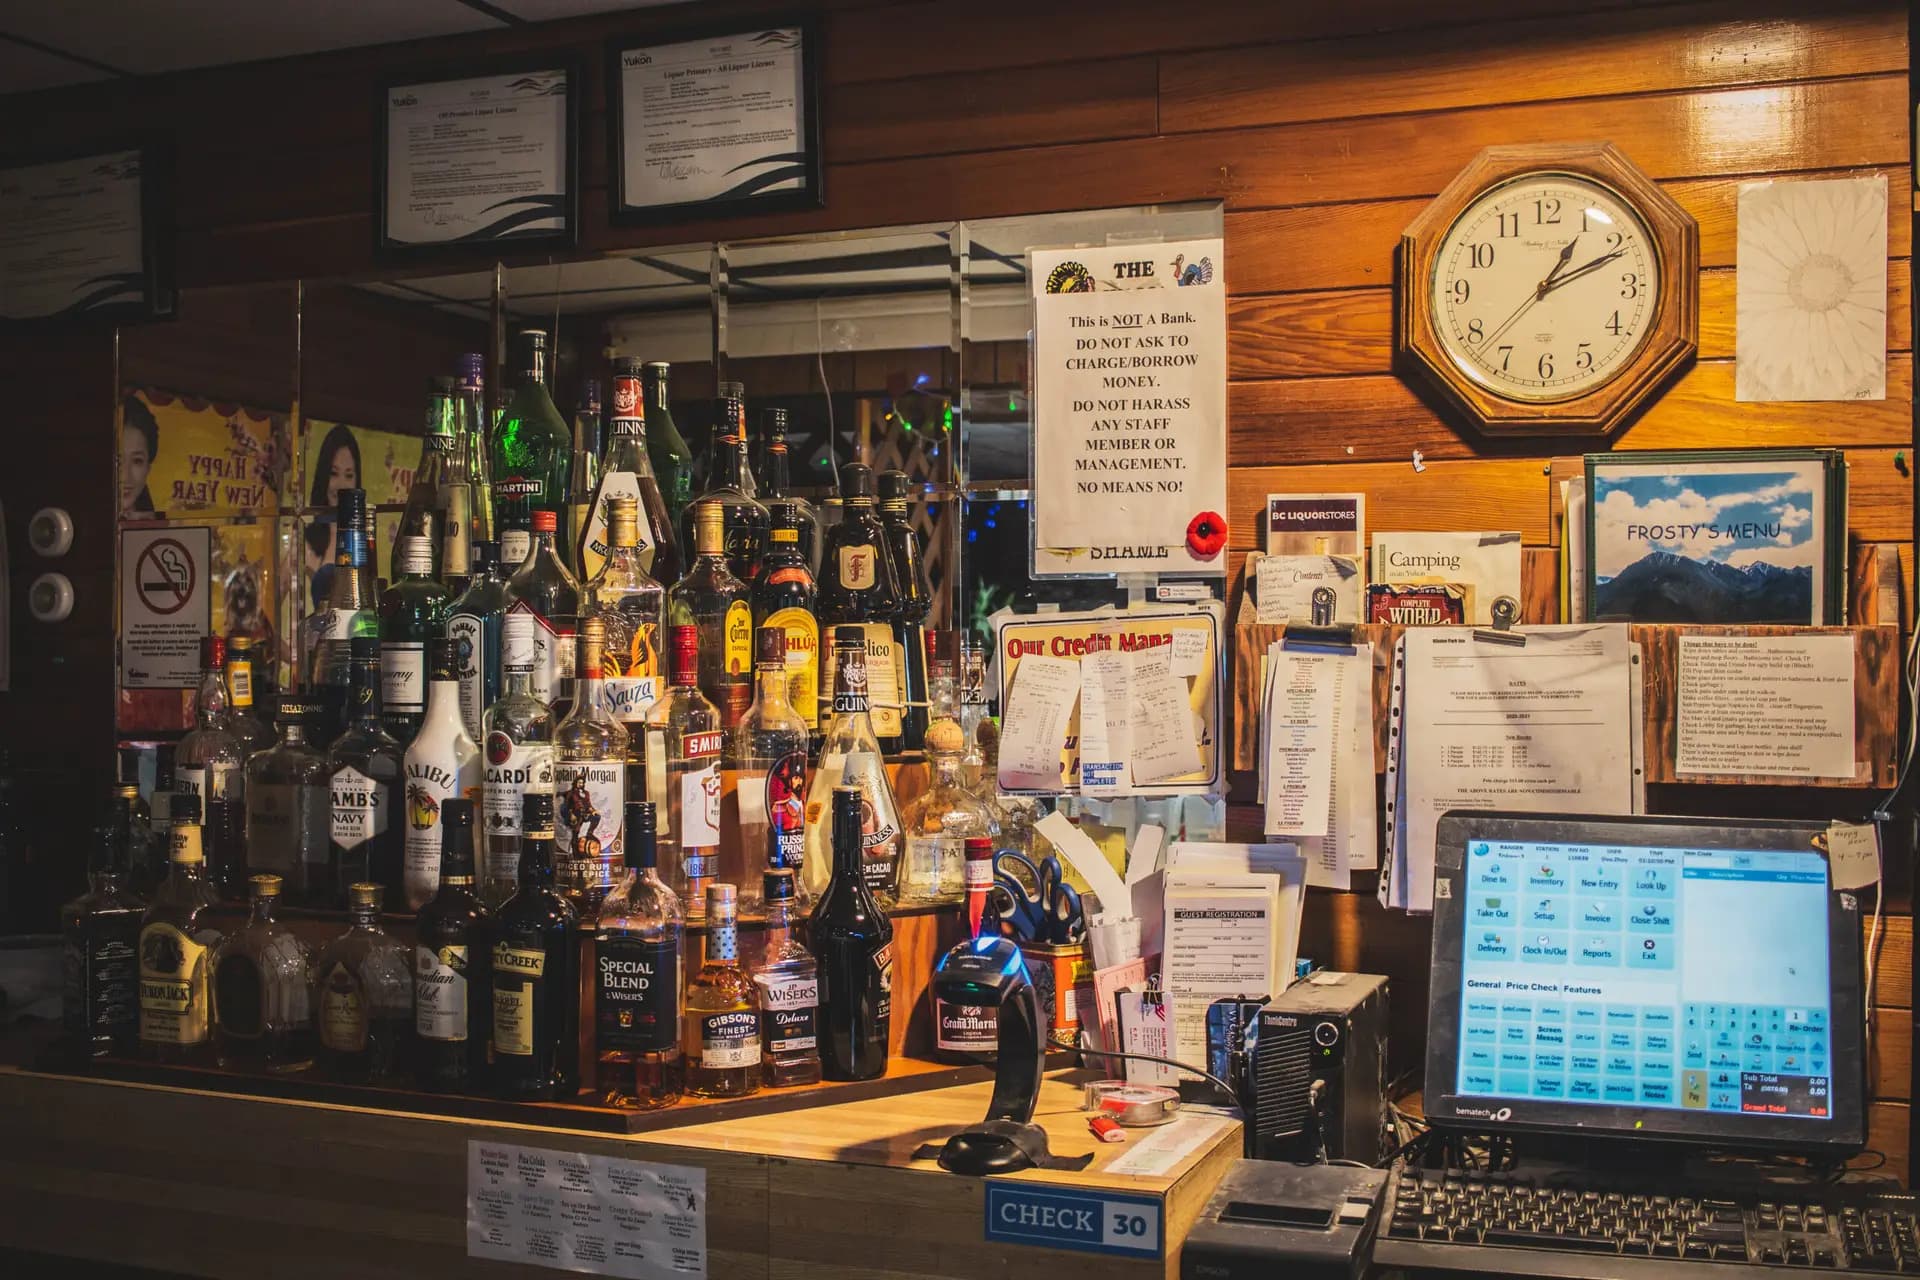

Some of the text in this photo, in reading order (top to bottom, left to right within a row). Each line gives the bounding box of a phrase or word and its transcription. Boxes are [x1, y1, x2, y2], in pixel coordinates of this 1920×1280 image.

[624, 54, 652, 67] Yukon
[1534, 199, 1562, 225] 12
[1581, 206, 1593, 233] 1
[1497, 212, 1521, 239] 11
[1466, 242, 1495, 269] 10
[1113, 260, 1155, 279] THE
[1453, 279, 1471, 305] 9
[1620, 273, 1638, 299] 3
[1069, 311, 1197, 329] This is NOT A Bank.
[1604, 310, 1624, 336] 4
[1467, 318, 1484, 344] 8
[1076, 335, 1189, 351] DO NOT ASK TO
[1065, 354, 1199, 370] CHARGE/BORROW
[1497, 345, 1514, 372] 7
[1576, 343, 1593, 369] 5
[1537, 353, 1555, 380] 6
[1102, 375, 1160, 389] MONEY.
[1073, 397, 1191, 413] DO NOT HARASS
[1090, 417, 1172, 432] ANY STAFF
[1085, 437, 1176, 452] MEMBER OR
[1074, 456, 1187, 472] MANAGEMENT.
[1077, 479, 1184, 494] NO MEANS NO!
[1272, 509, 1356, 521] BC LIQUORSTORES
[1627, 522, 1781, 540] FROSTY'S MENU
[1090, 546, 1169, 560] SHAME
[1390, 551, 1460, 571] Camping
[1388, 607, 1441, 625] WORLD
[1007, 638, 1045, 659] Our
[1051, 632, 1111, 658] Credit
[605, 681, 654, 713] Sauza
[690, 735, 721, 754] SMIR
[579, 766, 616, 785] Morgan
[331, 813, 366, 824] NAVY
[872, 862, 891, 873] CACAO
[1481, 875, 1507, 884] Dine In
[1530, 877, 1564, 887] Inventory
[1581, 879, 1618, 890] New Entry
[1636, 881, 1667, 891] Look Up
[1180, 911, 1258, 919] GUEST REGISTRATION
[1478, 909, 1509, 918] Take Out
[1534, 912, 1555, 921] Setup
[1585, 914, 1611, 922] Invoice
[1631, 916, 1670, 925] Close Shift
[1478, 944, 1507, 954] Delivery
[1522, 946, 1567, 956] Clock In/Out
[1583, 949, 1612, 958] Reports
[1642, 952, 1656, 960] Exit
[503, 952, 540, 969] CREEK
[599, 955, 655, 975] SPECIAL
[603, 972, 650, 990] BLEND
[1467, 980, 1602, 994] General Price Check Features
[610, 990, 644, 1002] WISER'S
[766, 985, 817, 1003] WISER'S
[708, 1013, 757, 1029] GIBSON'S
[775, 1012, 809, 1025] Deluxe
[717, 1025, 751, 1036] FINEST
[1537, 1026, 1562, 1034] Screen
[1687, 1050, 1702, 1058] Send
[1809, 1078, 1826, 1086] 0.00
[1689, 1092, 1700, 1102] Pay
[1809, 1088, 1826, 1096] 0.00
[1456, 1107, 1491, 1117] bematech
[1000, 1202, 1147, 1237] CHECK 30
